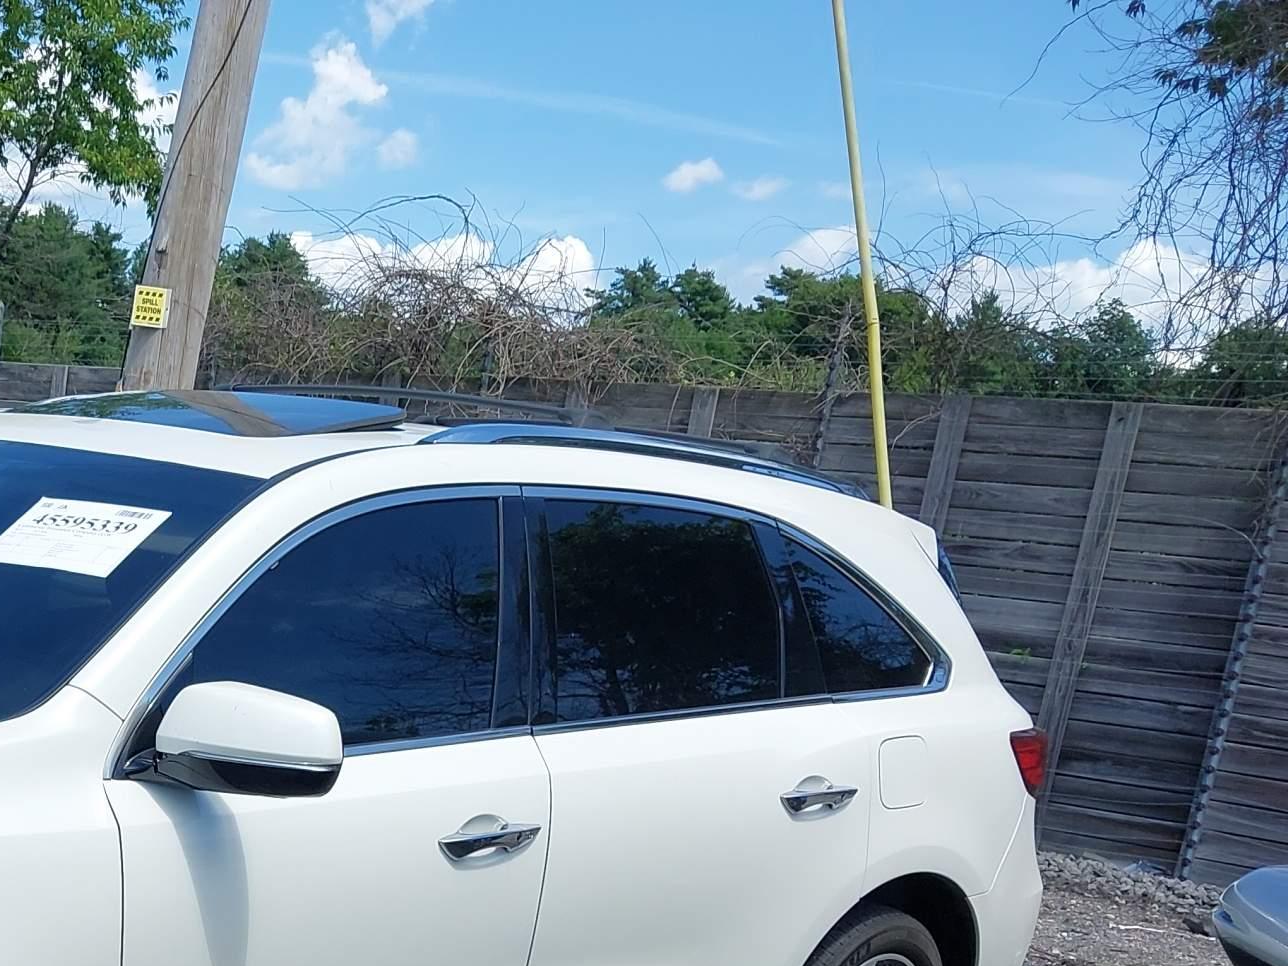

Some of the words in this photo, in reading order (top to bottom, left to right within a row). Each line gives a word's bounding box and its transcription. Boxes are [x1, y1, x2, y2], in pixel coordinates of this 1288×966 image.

[142, 298, 158, 306] SPILL
[136, 305, 161, 314] STATION
[32, 513, 138, 535] 45595339
